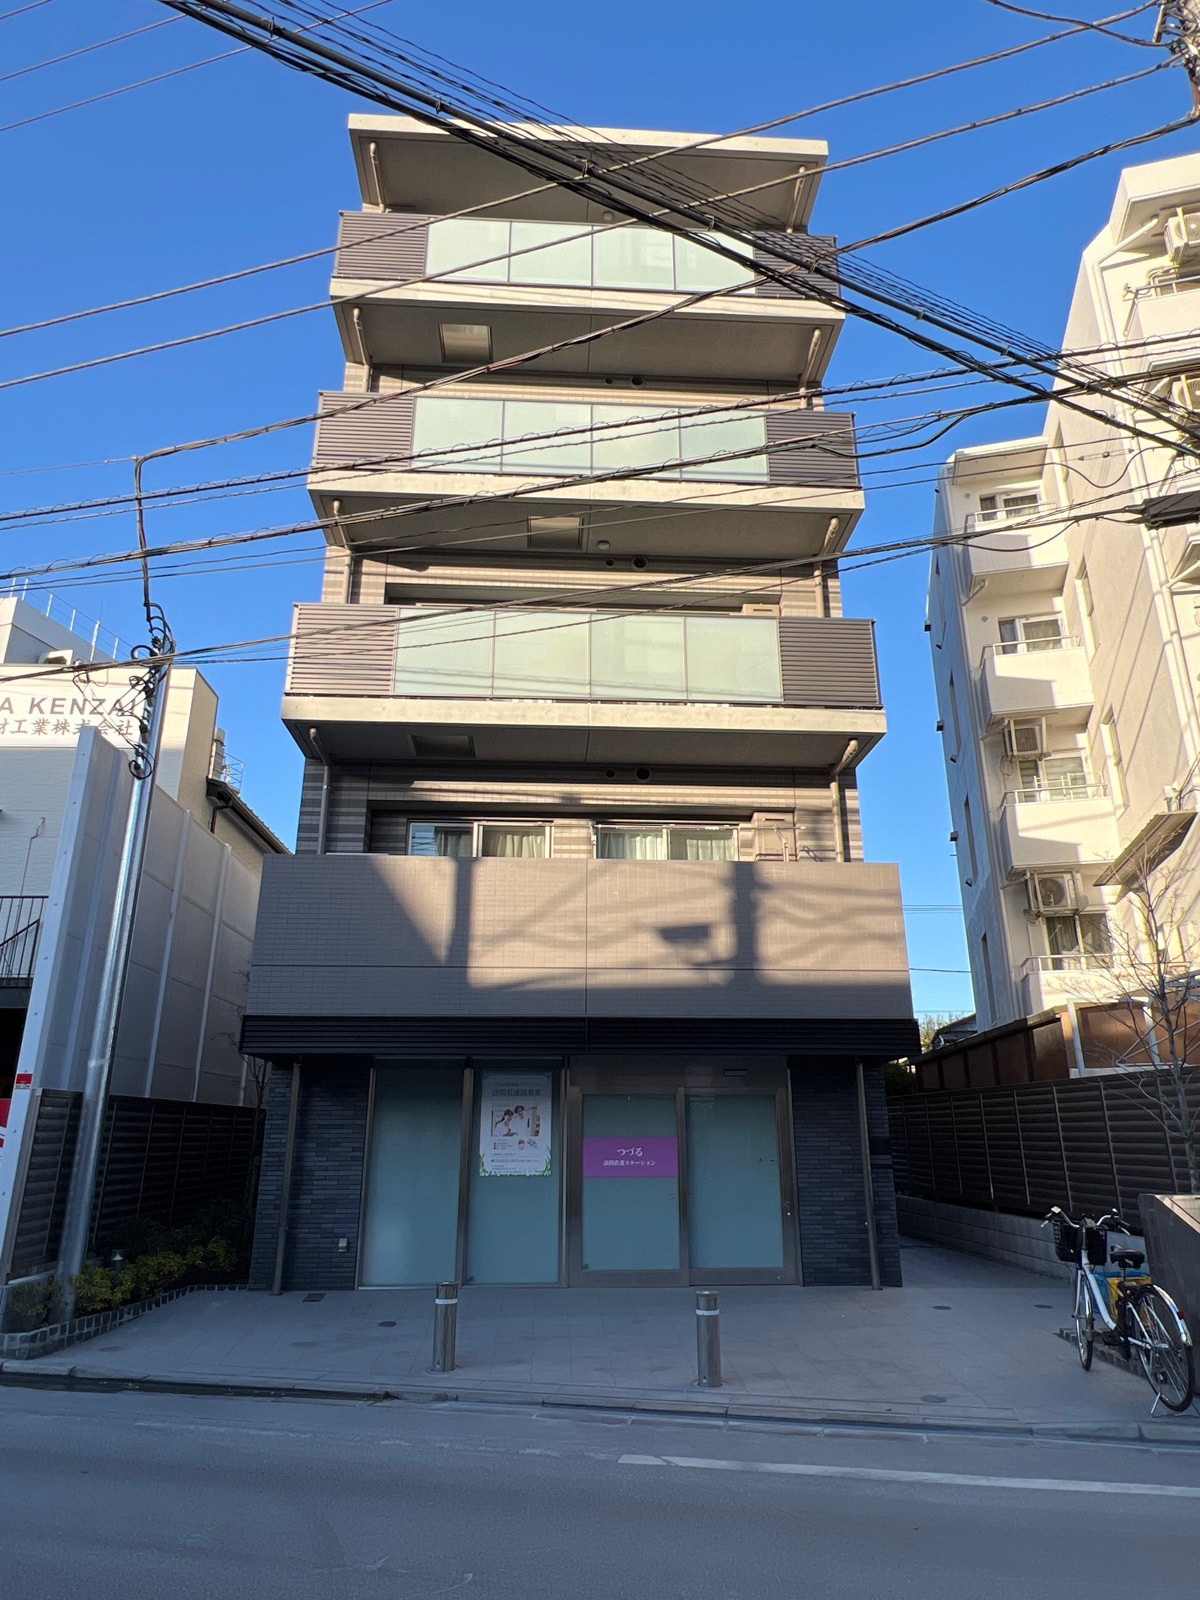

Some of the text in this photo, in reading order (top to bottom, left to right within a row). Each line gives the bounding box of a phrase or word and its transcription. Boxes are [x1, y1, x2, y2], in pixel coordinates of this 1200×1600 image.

[28, 697, 137, 715] KENZAI
[616, 1147, 643, 1157] つづる
